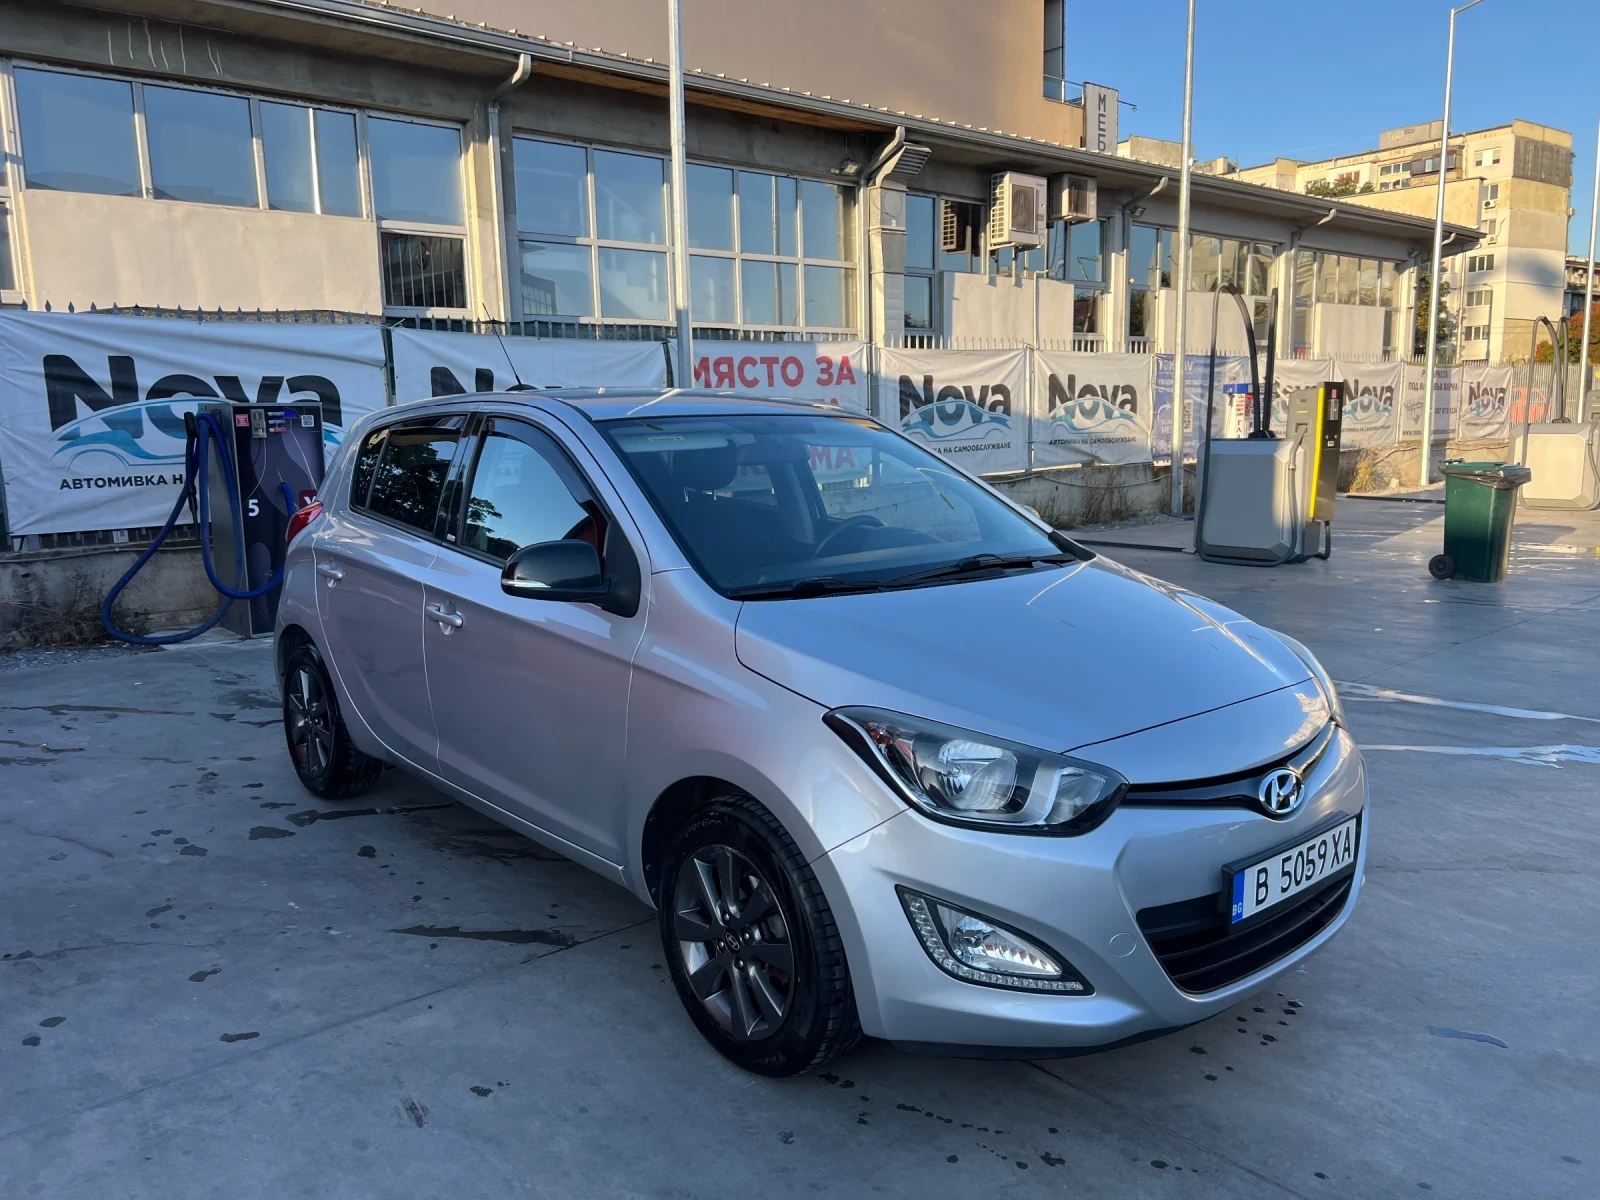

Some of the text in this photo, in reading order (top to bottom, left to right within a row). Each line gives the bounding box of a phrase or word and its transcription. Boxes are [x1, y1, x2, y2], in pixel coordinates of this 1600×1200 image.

[693, 355, 856, 388] МЯСТО ЗА
[899, 374, 1012, 426] Nova
[1048, 373, 1138, 420] Nova
[1342, 378, 1394, 413] Nova
[1468, 381, 1506, 411] Nova
[953, 442, 1012, 453] САМООБСЛУЖВАНЕ
[59, 474, 184, 490] АВТОМИВКА Н
[248, 499, 259, 517] 5
[1255, 826, 1351, 907] B 5059 XA
[1232, 902, 1243, 916] BG
